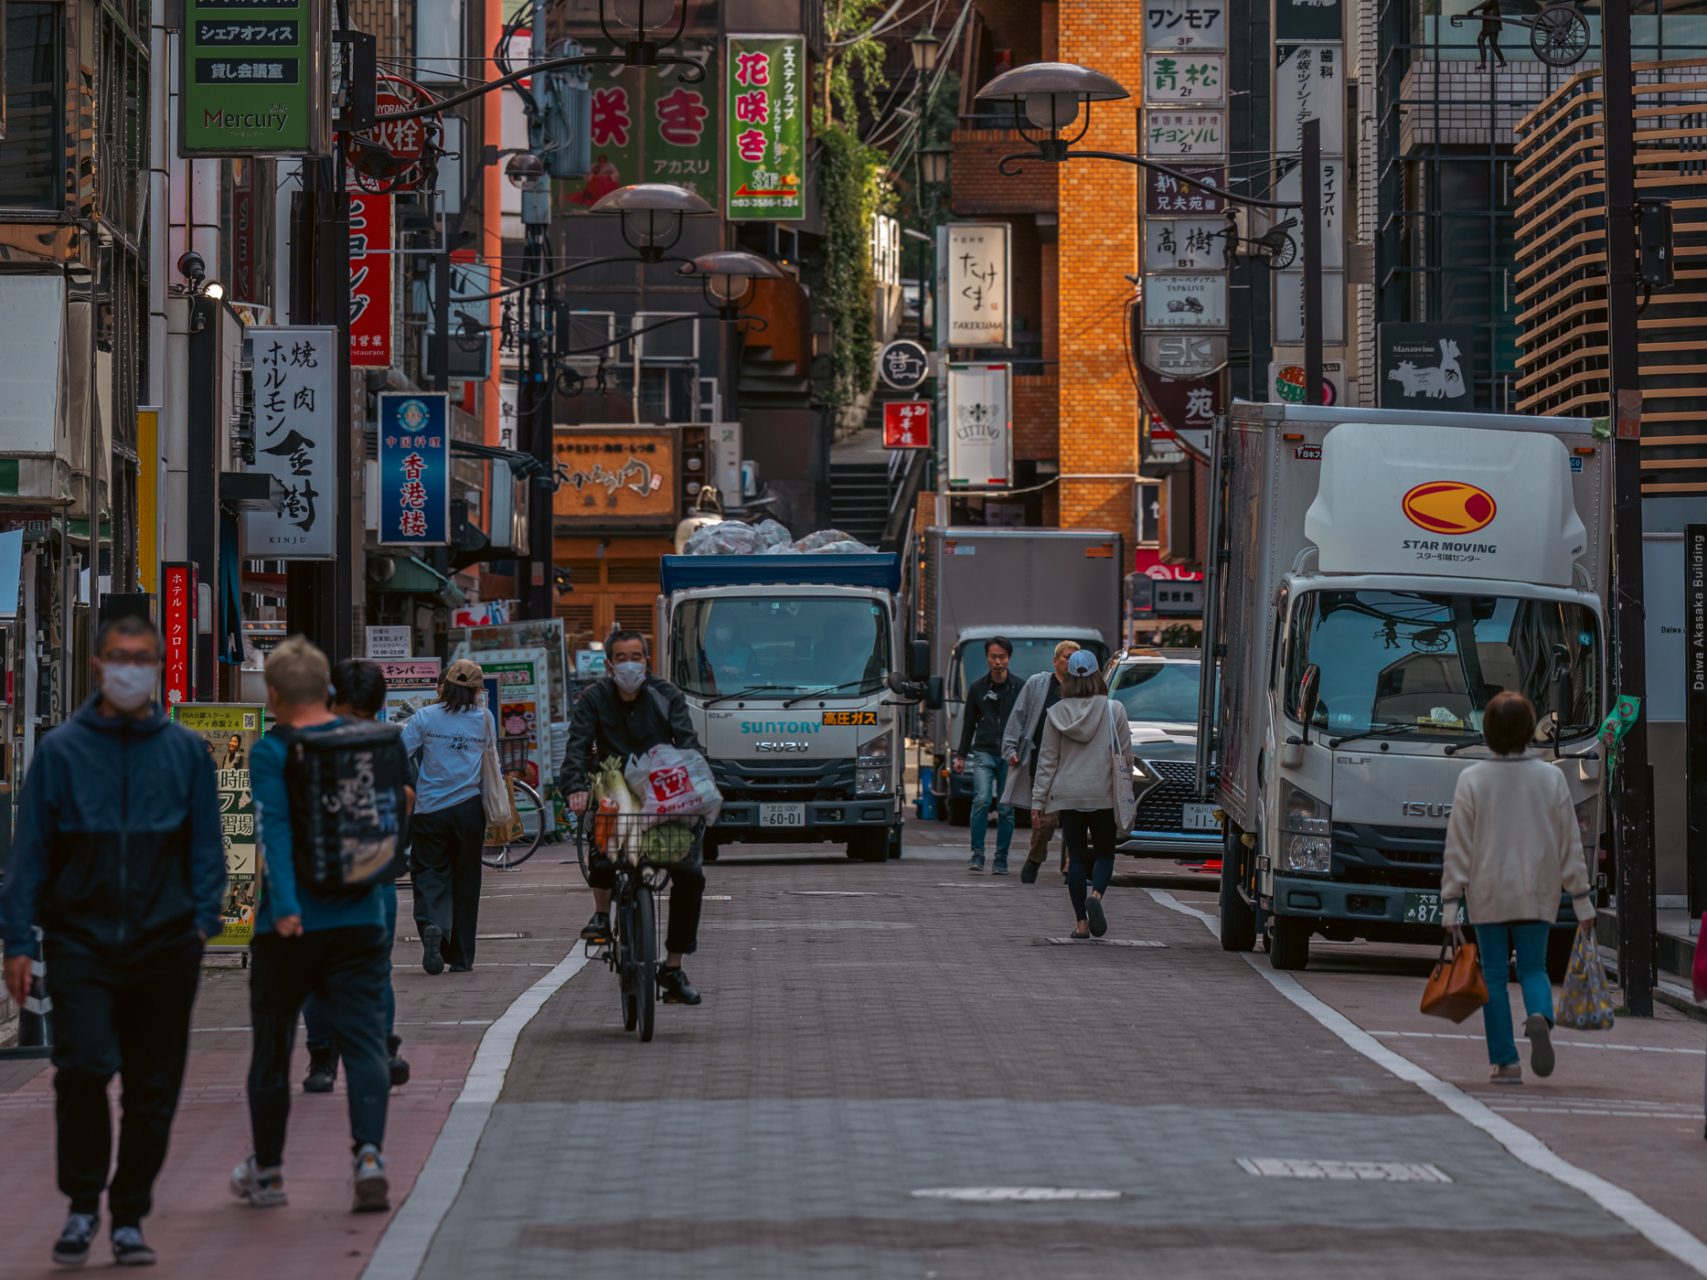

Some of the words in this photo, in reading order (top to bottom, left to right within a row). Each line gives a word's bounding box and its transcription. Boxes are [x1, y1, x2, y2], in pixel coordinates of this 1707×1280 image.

[1148, 10, 1221, 29] ワンモア
[200, 25, 293, 42] シェアオフィス
[1177, 37, 1193, 46] 3F
[211, 61, 283, 80] 貸し会議室
[1320, 49, 1334, 79] 歯科
[784, 46, 795, 120] エステクラブ
[1153, 58, 1218, 90] 青松
[1180, 86, 1193, 97] 2F
[736, 52, 769, 162] 花咲き
[203, 107, 288, 132] Mercury
[1180, 142, 1193, 153] 2F
[653, 159, 710, 174] アカスリ
[1157, 196, 1204, 210] 兄夫苑
[1323, 166, 1336, 228] ライブバー
[1178, 259, 1194, 268] B1
[1159, 337, 1212, 360] SK
[289, 341, 318, 413] 焼肉
[262, 340, 288, 439] ホルモン
[1186, 388, 1215, 420] 苑
[385, 436, 442, 449] 中国料理
[1303, 450, 1321, 458] 日本フ
[400, 452, 429, 537] 香港楼
[269, 536, 307, 544] KINJU
[1402, 540, 1439, 551] STAR
[1441, 541, 1497, 554] MOVING
[1693, 535, 1705, 587] Building
[172, 573, 182, 684] ホテル・クローバー
[1693, 592, 1704, 647] Akasaka
[1694, 652, 1705, 690] Daiwa
[740, 721, 822, 734] SUNTORY
[823, 712, 877, 725] 高圧ガス
[756, 741, 809, 753] ISUZU
[1337, 757, 1372, 765] ELF
[769, 813, 801, 824] 60-01
[1420, 895, 1437, 904] 大宮
[1418, 905, 1464, 924] 87-4
